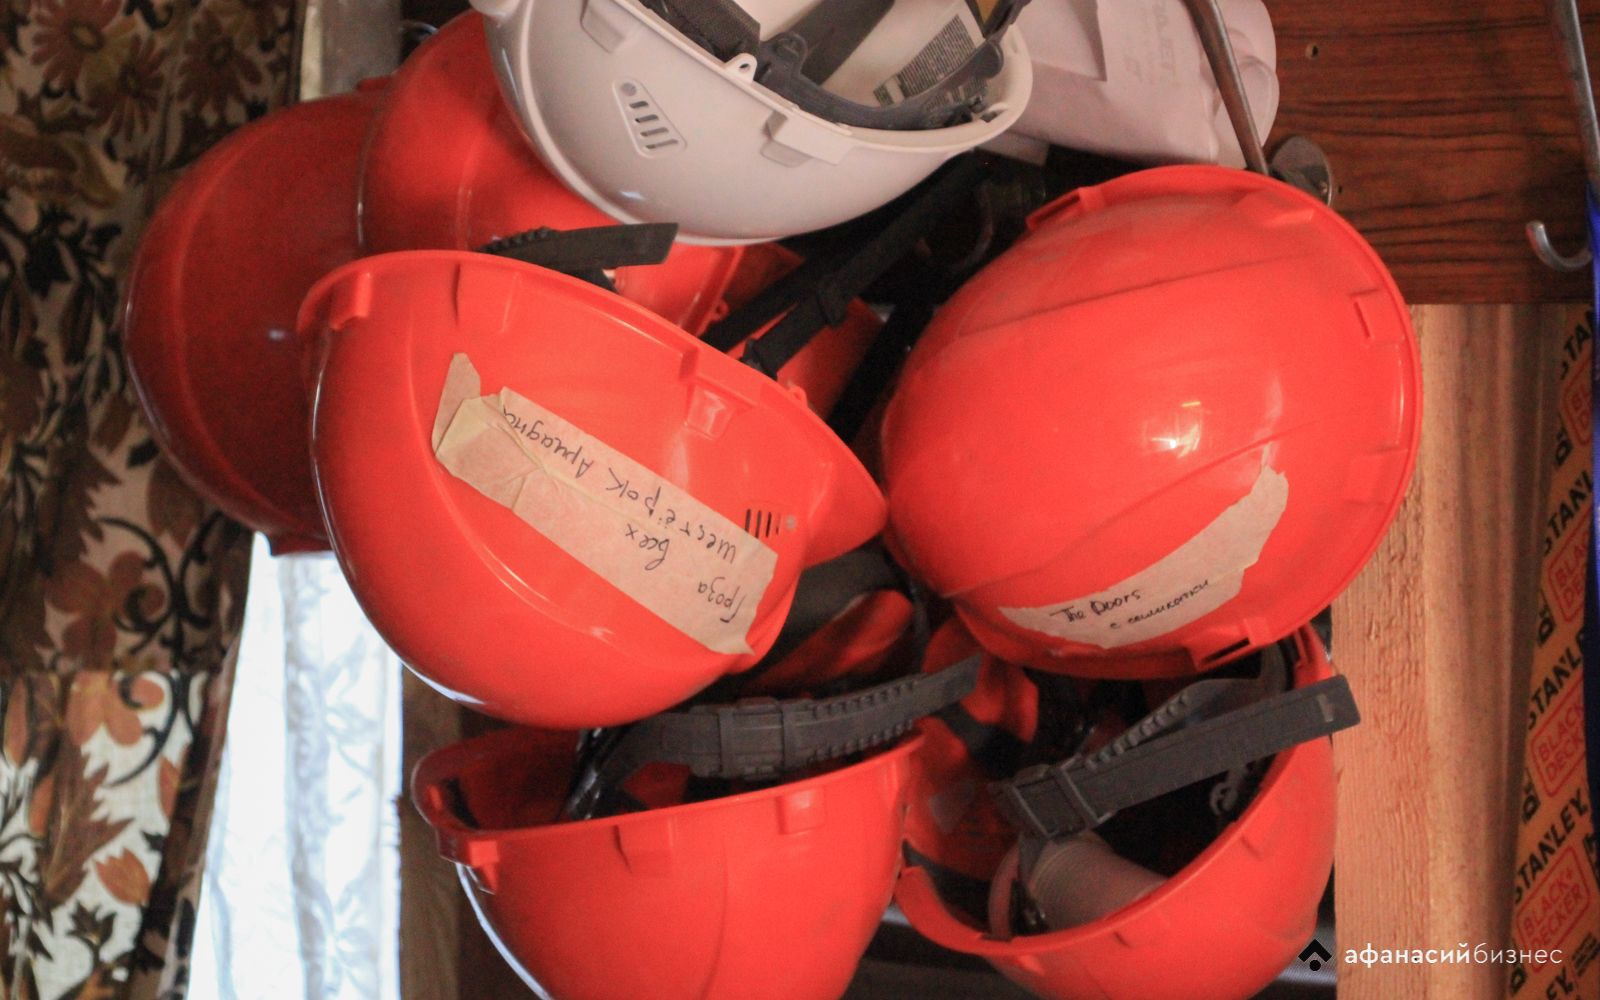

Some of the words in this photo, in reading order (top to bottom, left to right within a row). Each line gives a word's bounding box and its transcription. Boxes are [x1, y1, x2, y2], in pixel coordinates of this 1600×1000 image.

[698, 576, 746, 623] Гроза
[1050, 605, 1086, 623] The
[1090, 589, 1141, 616] Doors
